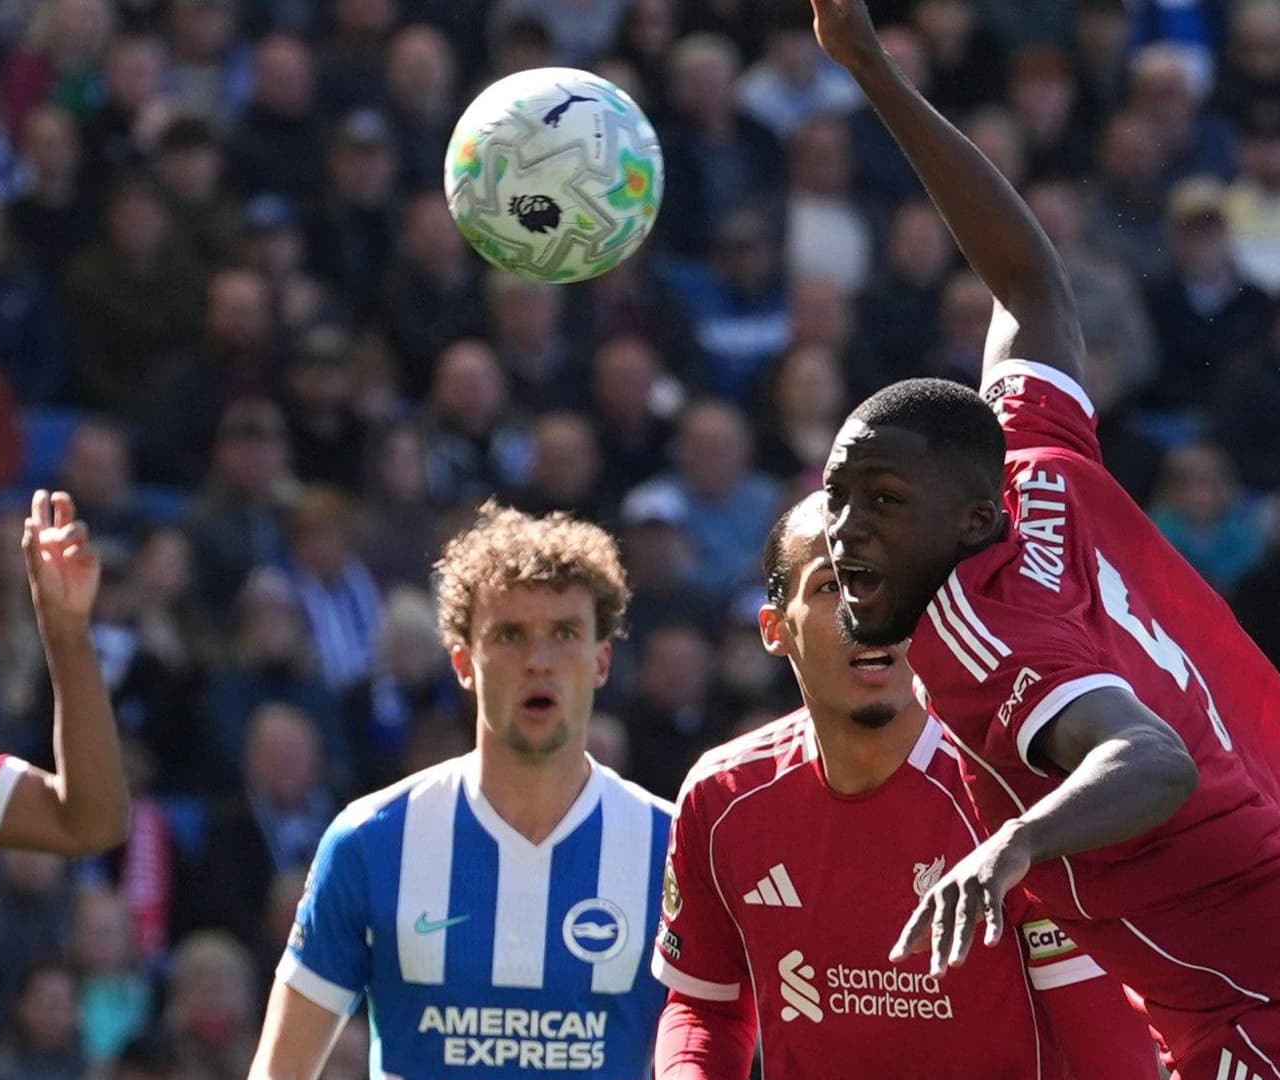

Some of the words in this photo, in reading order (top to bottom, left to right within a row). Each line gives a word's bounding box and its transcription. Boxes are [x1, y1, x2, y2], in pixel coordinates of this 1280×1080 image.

[1018, 469, 1066, 593] KOATE
[829, 989, 953, 1019] chartered
[418, 1005, 608, 1040] AMERICAN
[444, 1036, 606, 1070] EXPRESS
